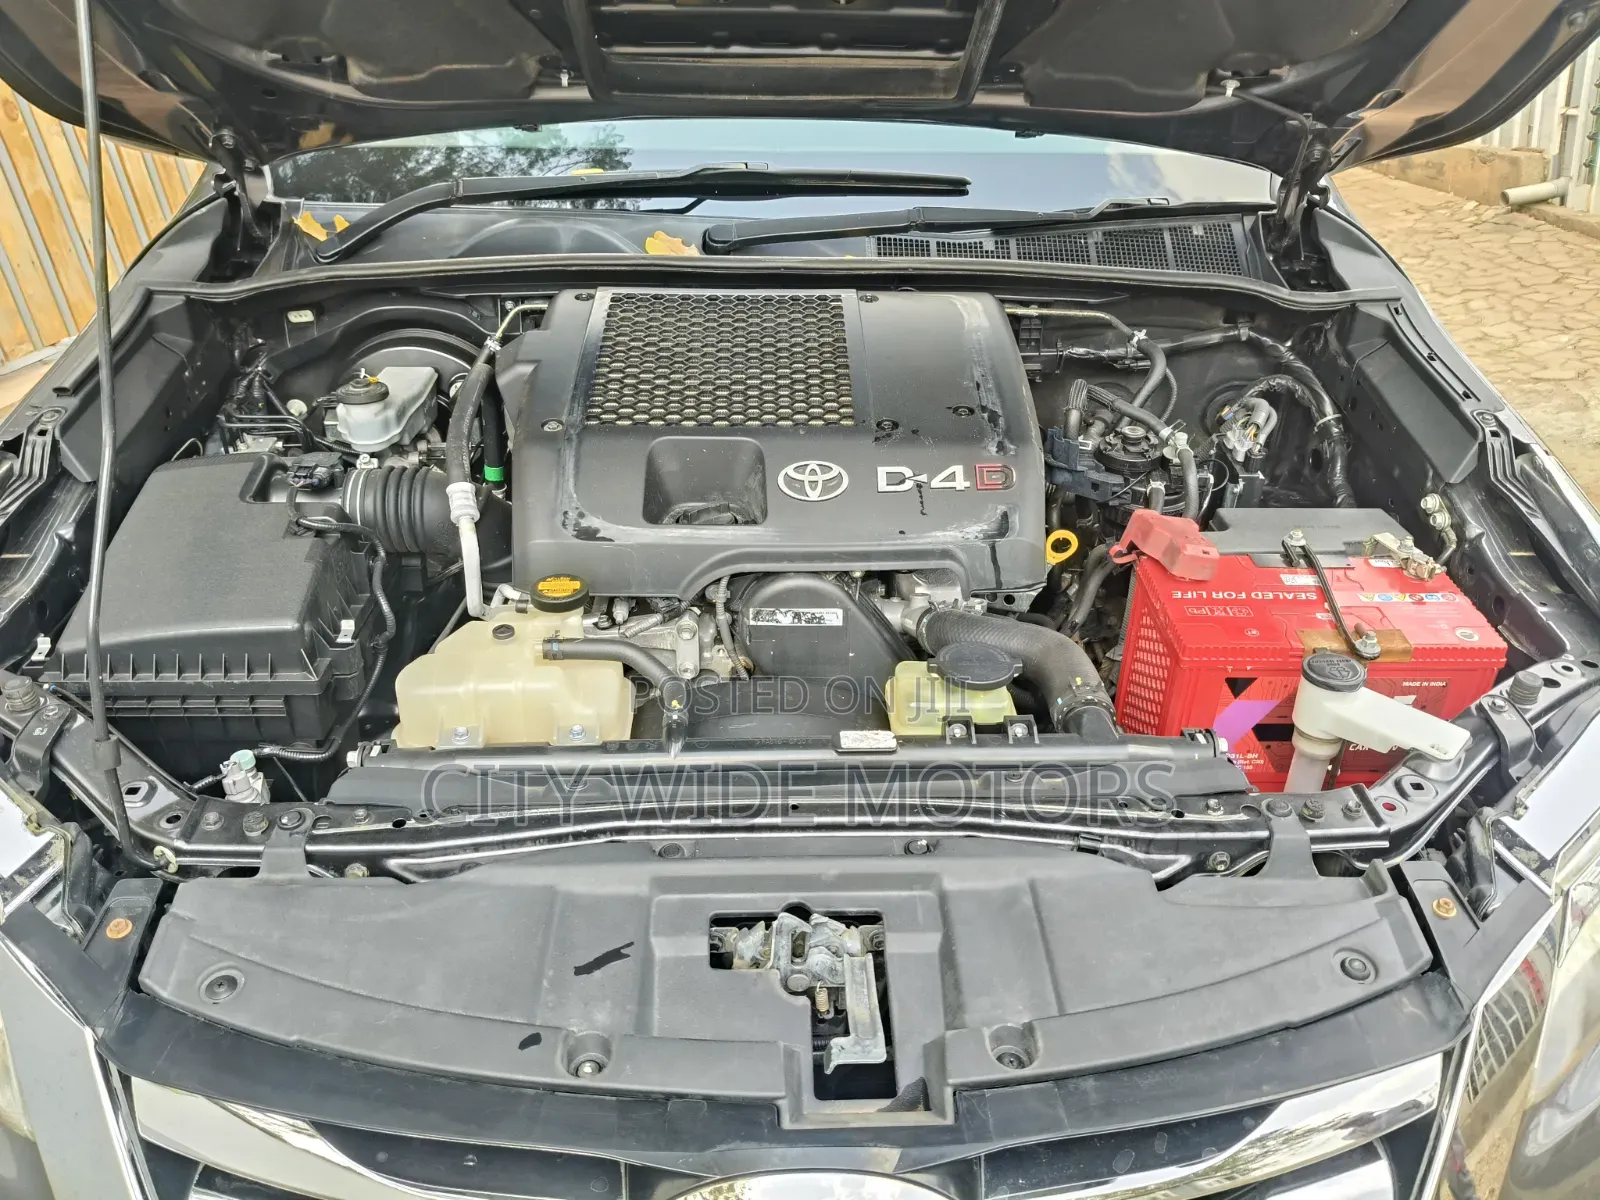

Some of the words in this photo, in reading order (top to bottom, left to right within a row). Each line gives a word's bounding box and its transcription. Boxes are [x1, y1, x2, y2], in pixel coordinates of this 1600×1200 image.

[1171, 590, 1207, 599] LIFE
[1212, 591, 1246, 599] FOR
[1251, 591, 1318, 600] SEALED
